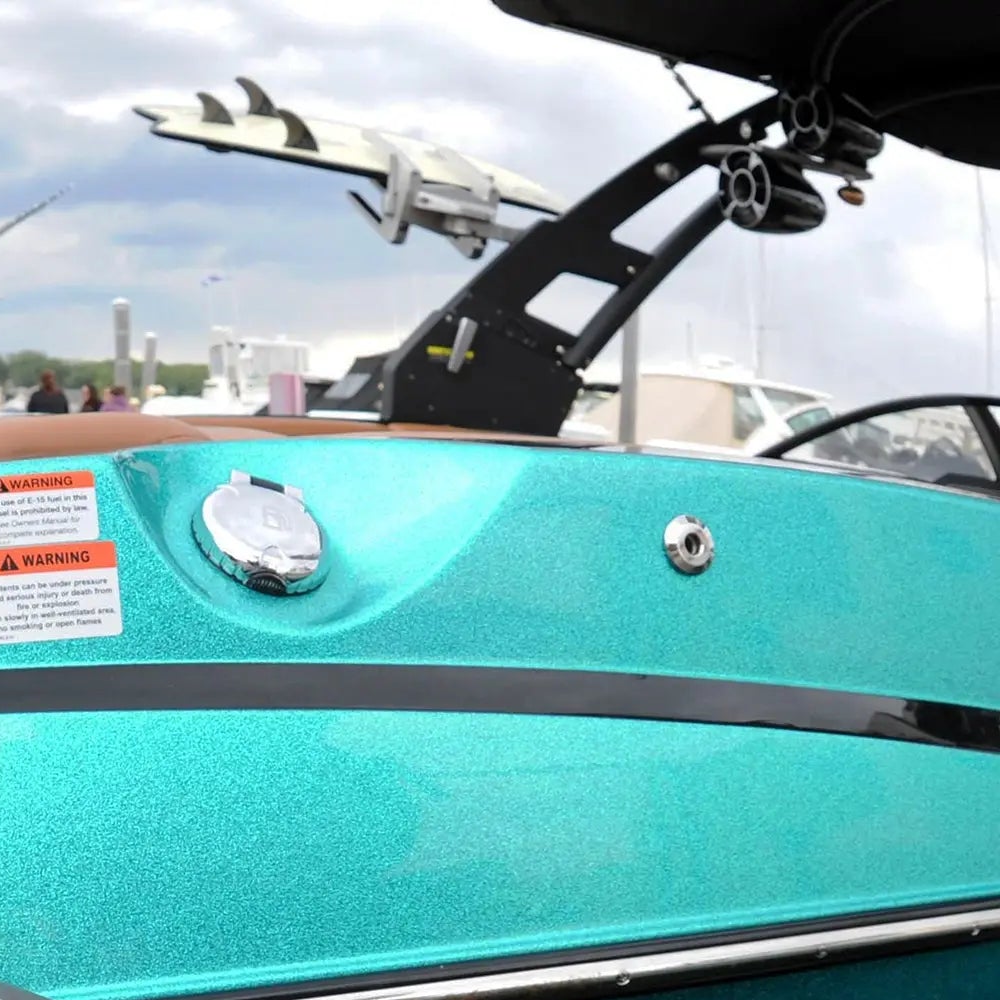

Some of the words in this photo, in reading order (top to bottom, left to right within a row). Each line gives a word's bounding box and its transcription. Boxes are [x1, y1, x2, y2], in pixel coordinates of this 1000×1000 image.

[9, 476, 73, 489] WARNING
[1, 498, 15, 506] use
[18, 497, 25, 505] of
[47, 495, 62, 503] fuel
[11, 508, 18, 516] is
[20, 506, 61, 517] prohibited
[62, 506, 71, 514] by
[22, 551, 91, 567] WARNING
[22, 583, 36, 591] can
[37, 581, 47, 589] be
[49, 580, 71, 588] under
[74, 578, 108, 587] pressure
[6, 593, 34, 602] serious
[37, 591, 59, 600] injury
[71, 588, 93, 597] death
[95, 587, 113, 595] from
[16, 603, 29, 611] fire
[42, 600, 79, 610] explosion
[4, 613, 28, 623] slowly
[41, 608, 95, 619] well-ventilated
[10, 621, 43, 631] smoking
[55, 620, 75, 629] open
